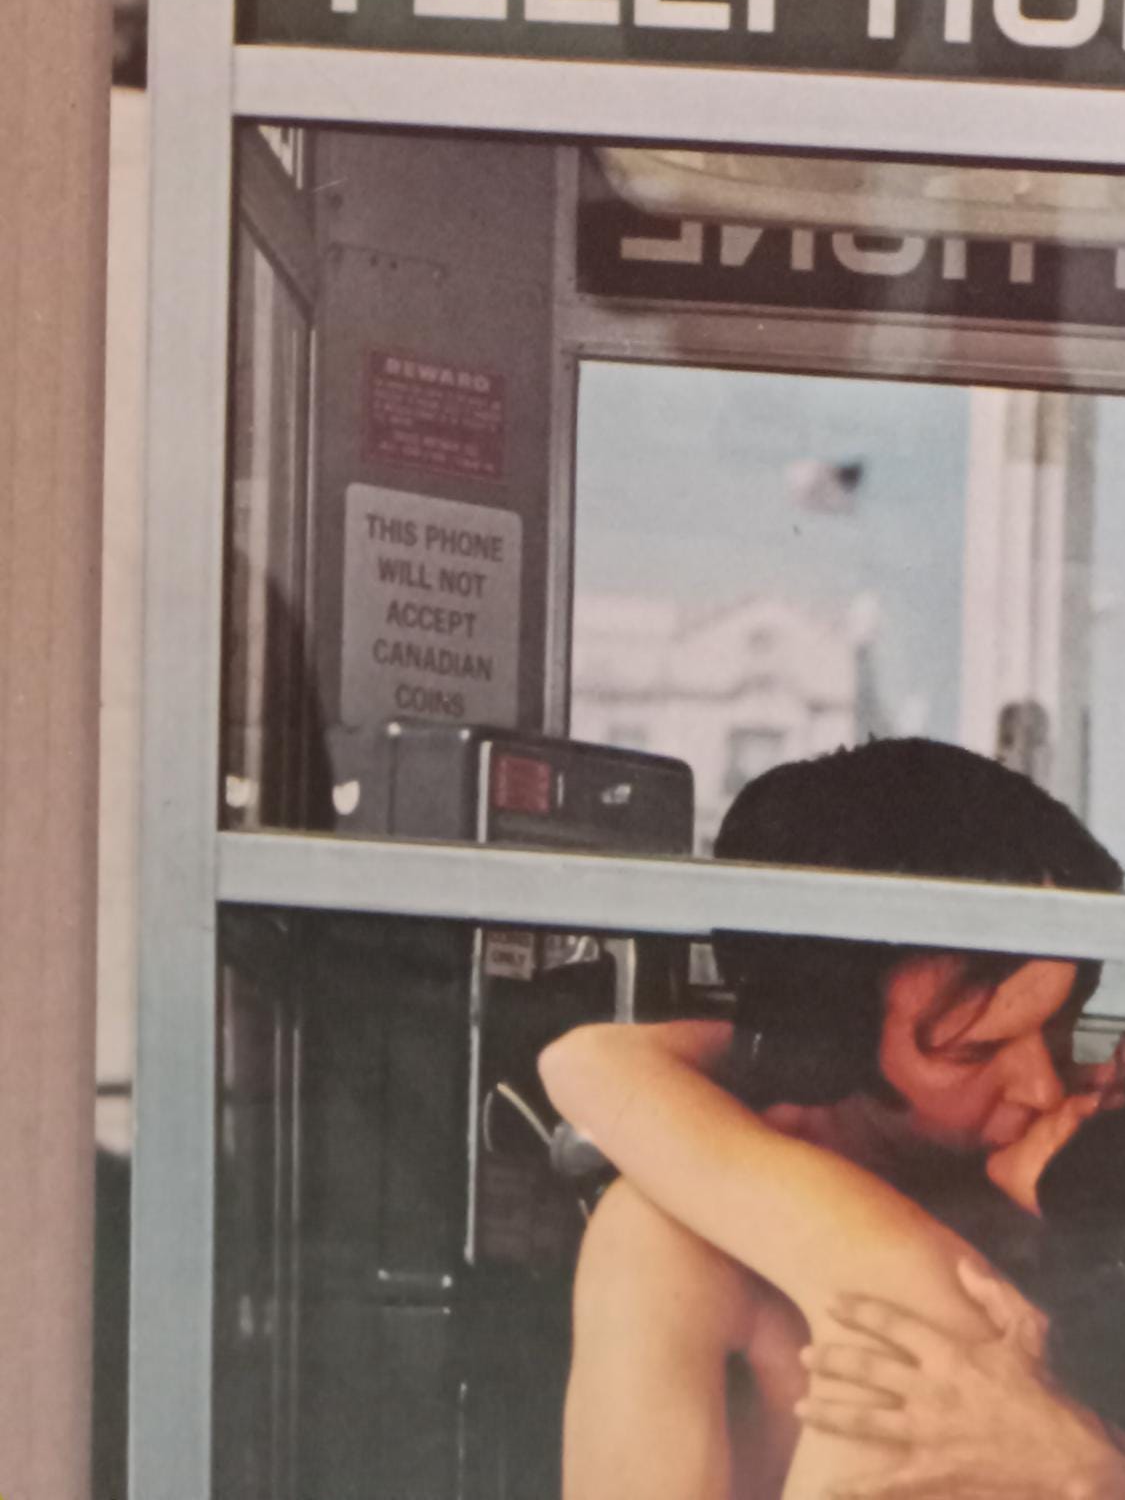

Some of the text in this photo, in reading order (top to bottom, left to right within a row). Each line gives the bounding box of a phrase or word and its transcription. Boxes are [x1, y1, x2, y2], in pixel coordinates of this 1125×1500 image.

[384, 356, 491, 393] REWARD
[365, 512, 504, 563] THIS PHONE
[377, 557, 487, 598] WILL NOT
[385, 600, 477, 638] ACCEPT
[372, 638, 494, 682] CANADIAN
[395, 683, 466, 718] COINS
